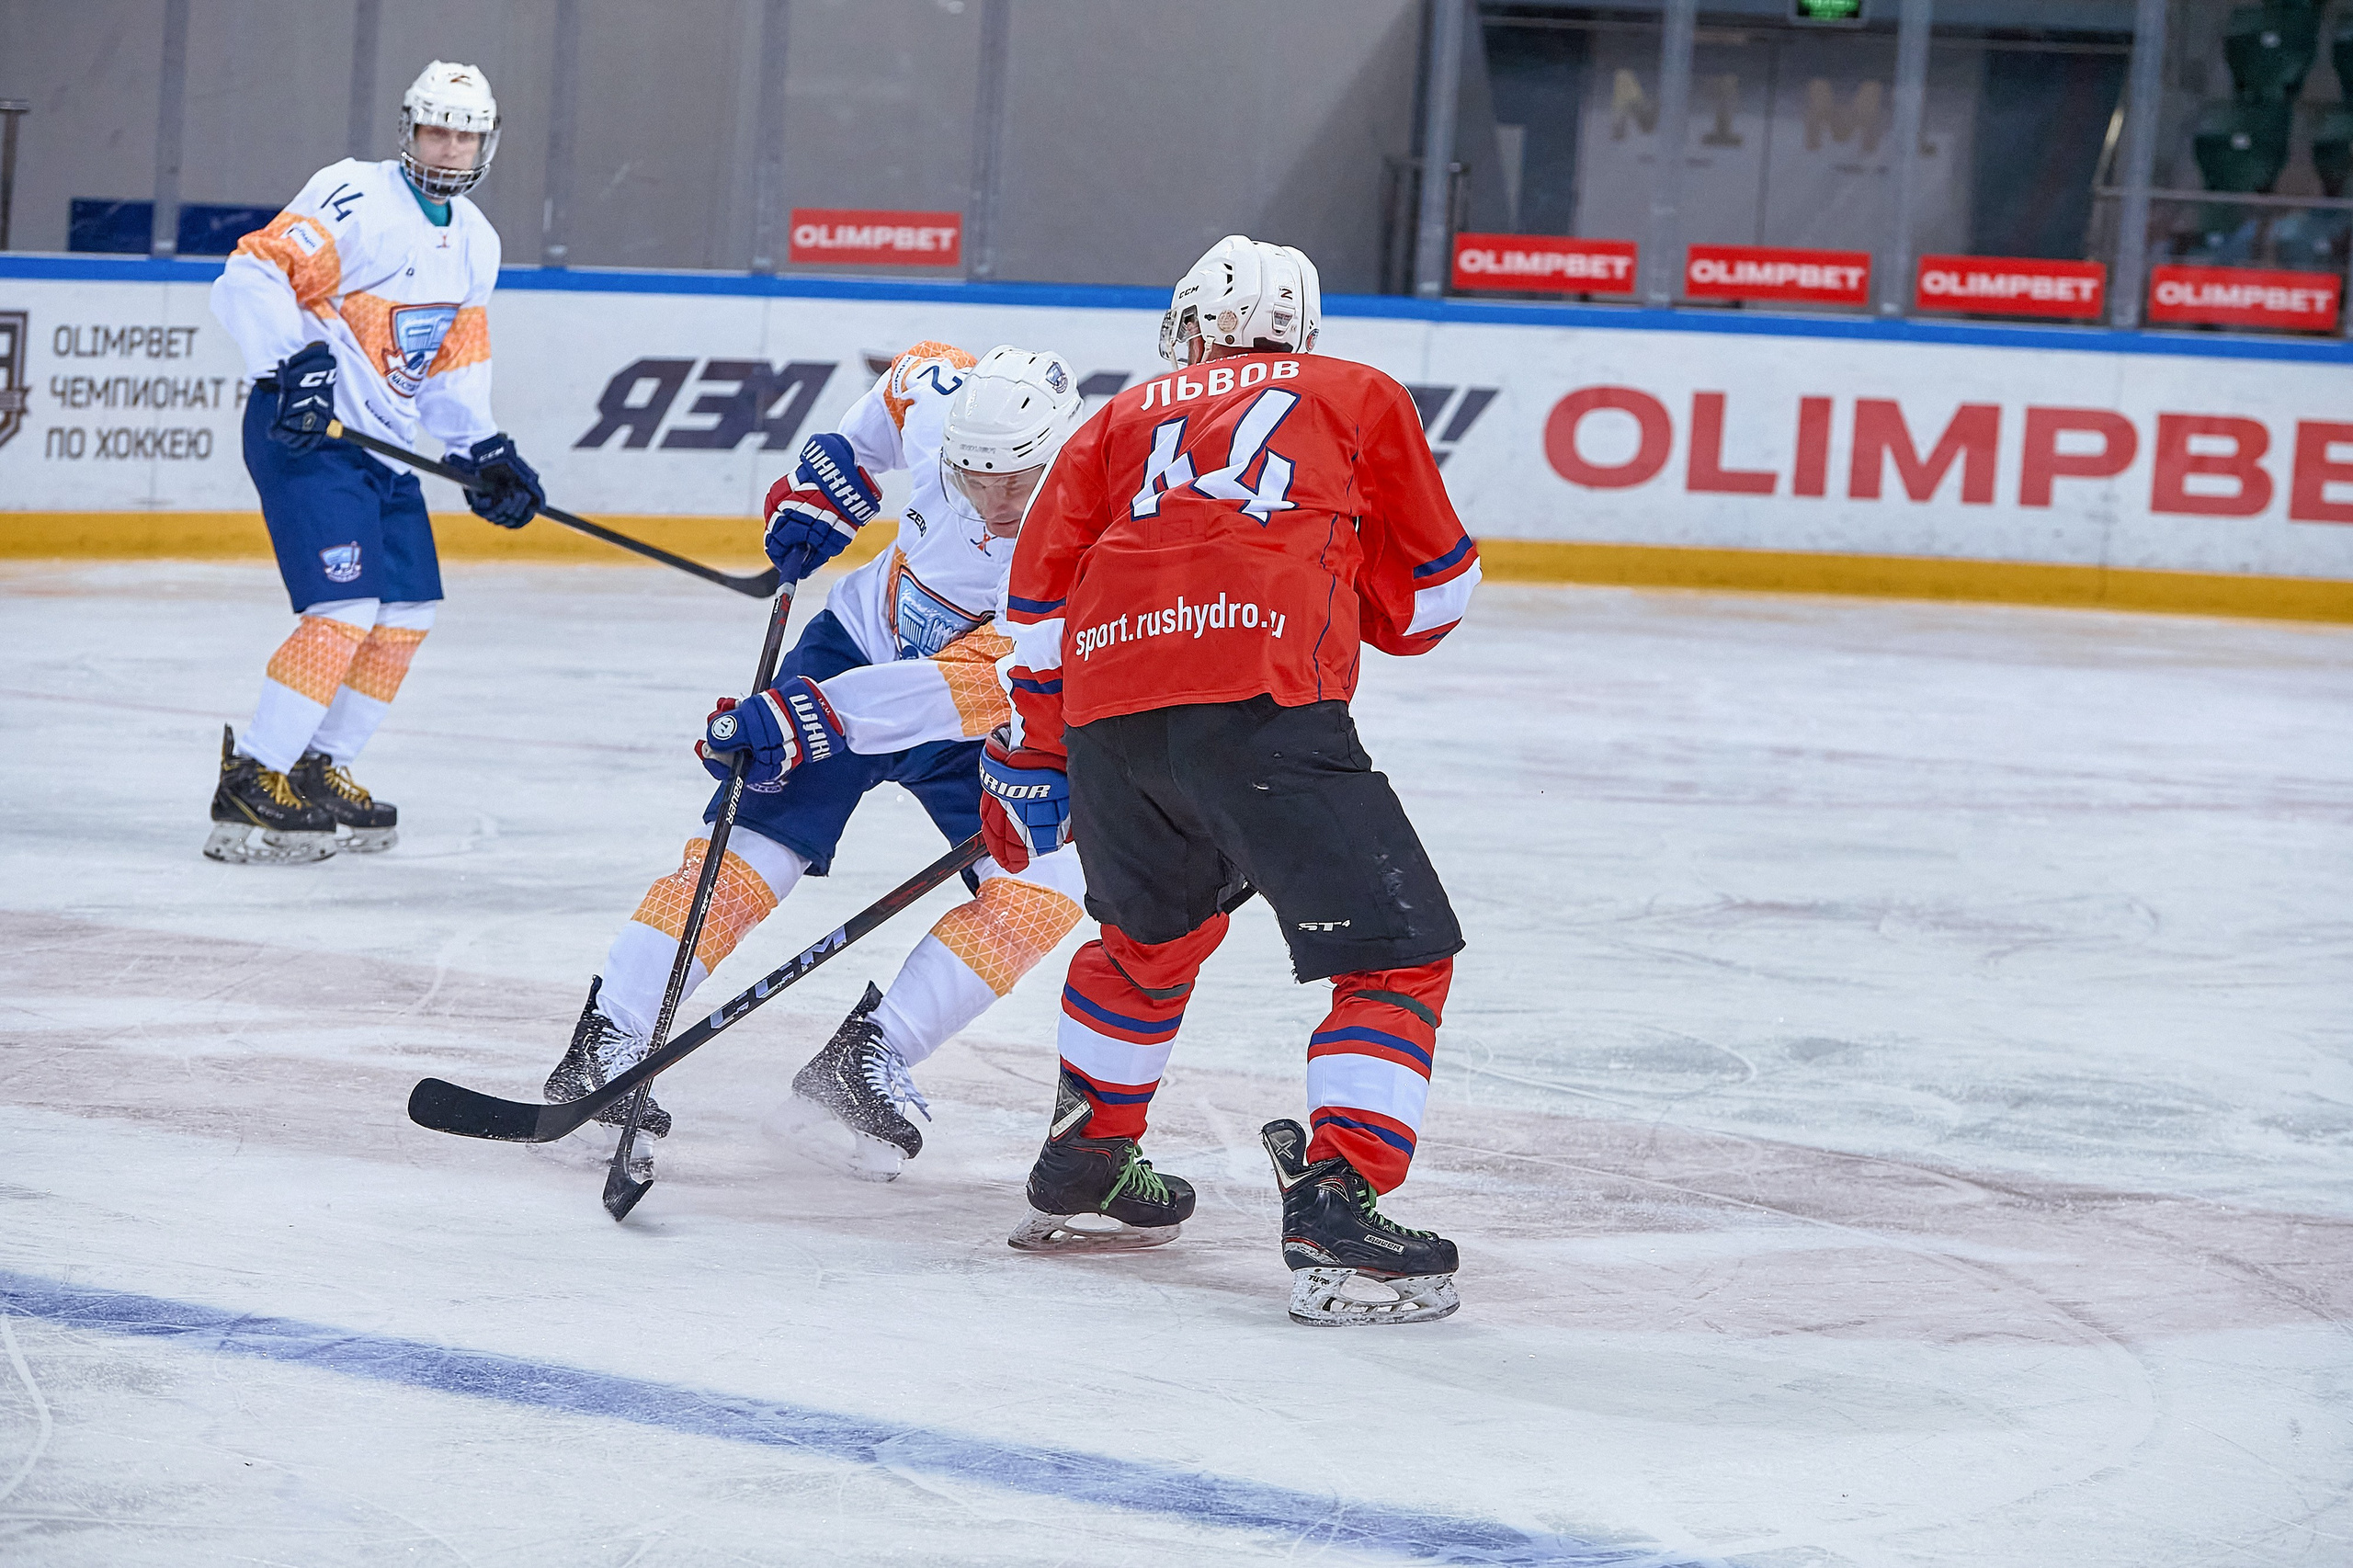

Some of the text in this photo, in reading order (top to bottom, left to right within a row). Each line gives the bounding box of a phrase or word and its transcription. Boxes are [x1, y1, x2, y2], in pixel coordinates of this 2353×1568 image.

[320, 183, 364, 222] 14
[793, 223, 957, 251] OLIMPBET
[1459, 249, 1632, 279] OLIMPBET
[1691, 259, 1865, 290] OLIMPBET
[1178, 285, 1199, 300] CCM
[1923, 271, 2098, 302] OLIMPBET
[2156, 282, 2334, 313] OLIMPBET
[52, 324, 199, 358] OLIMPBET
[50, 375, 226, 409] ЧЕМПИОНАТ
[1140, 360, 1302, 412] ЛЬВОВ
[46, 426, 213, 460] ПО ХОККЕЮ
[1544, 385, 2353, 525] OLIMPBE
[801, 439, 879, 526] WARRIO
[1075, 592, 1286, 661] sport.rushydro.u
